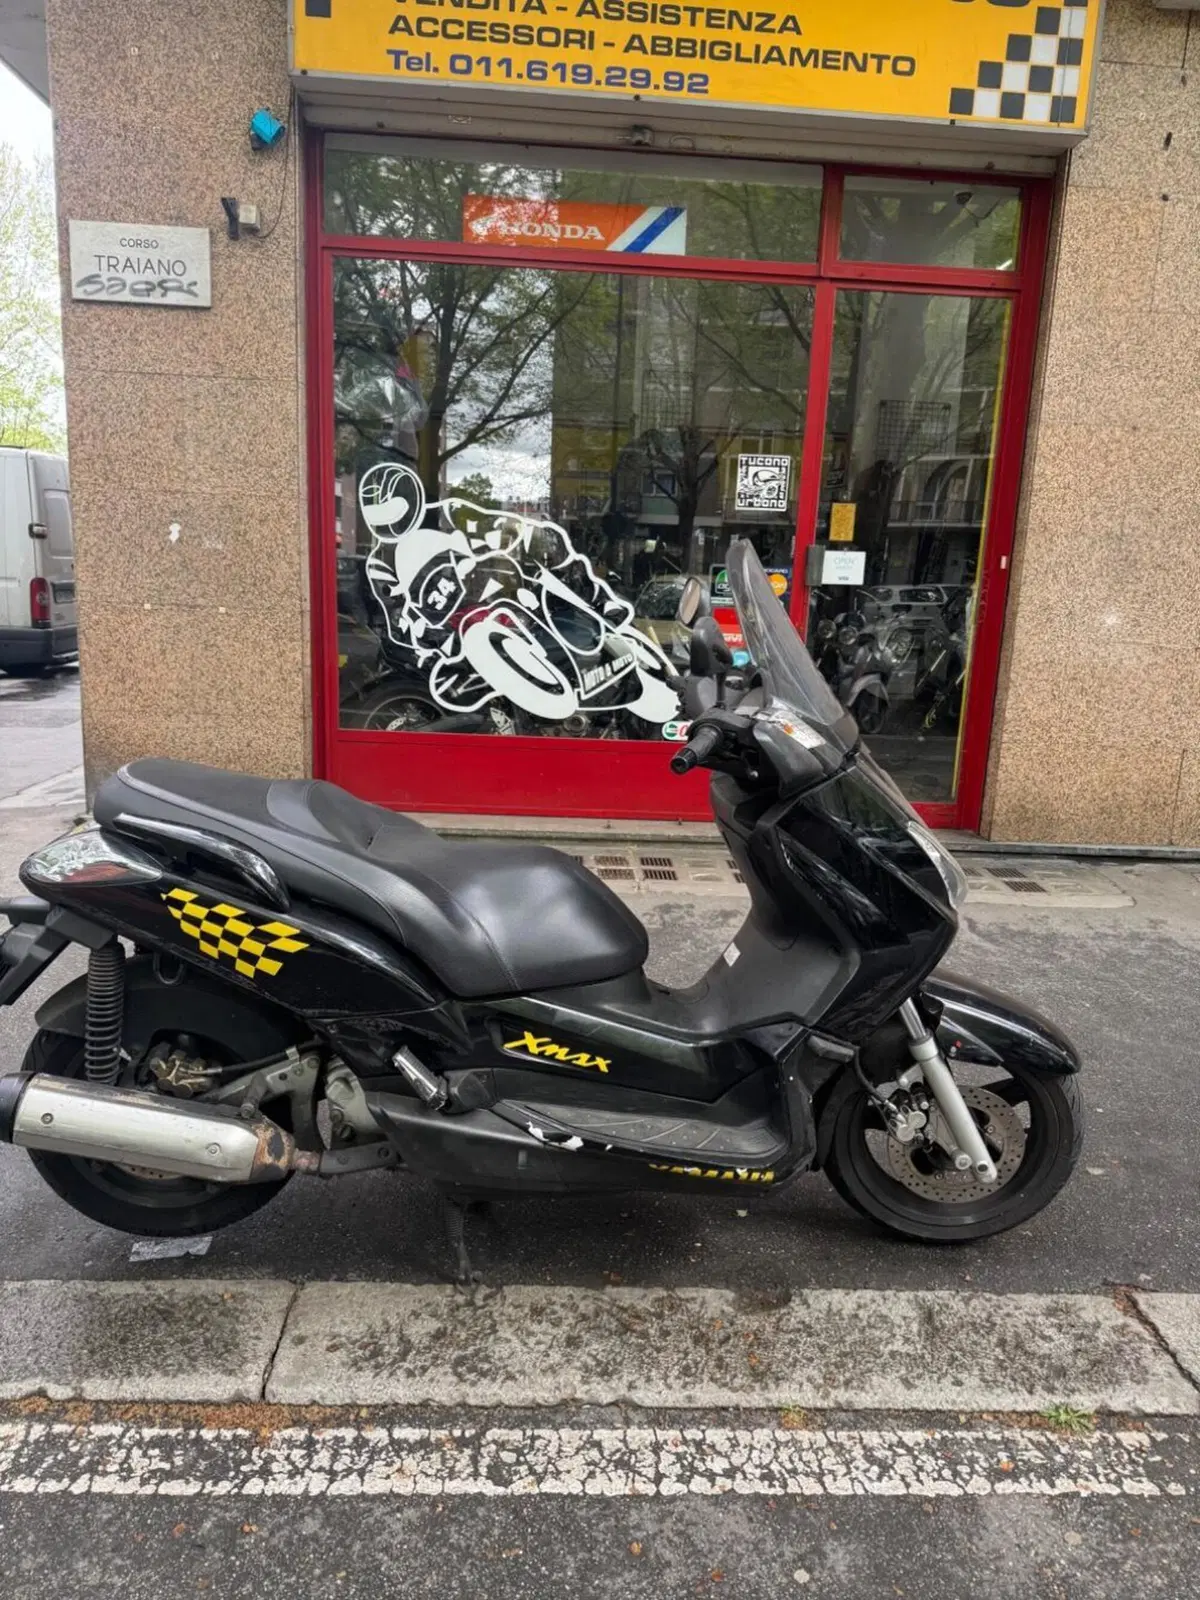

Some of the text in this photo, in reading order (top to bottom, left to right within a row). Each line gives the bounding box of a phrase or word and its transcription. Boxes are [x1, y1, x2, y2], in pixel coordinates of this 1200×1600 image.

[575, 0, 802, 35] ASSISTENZA
[388, 15, 595, 50] ACCESSORI
[623, 34, 916, 77] ABBIGLIAMENTO
[386, 48, 709, 94] Tel. 011.619.29.92
[119, 237, 159, 249] CORSO
[499, 221, 605, 241] HONDA
[94, 254, 187, 277] TRAIANO
[427, 577, 457, 610] 34
